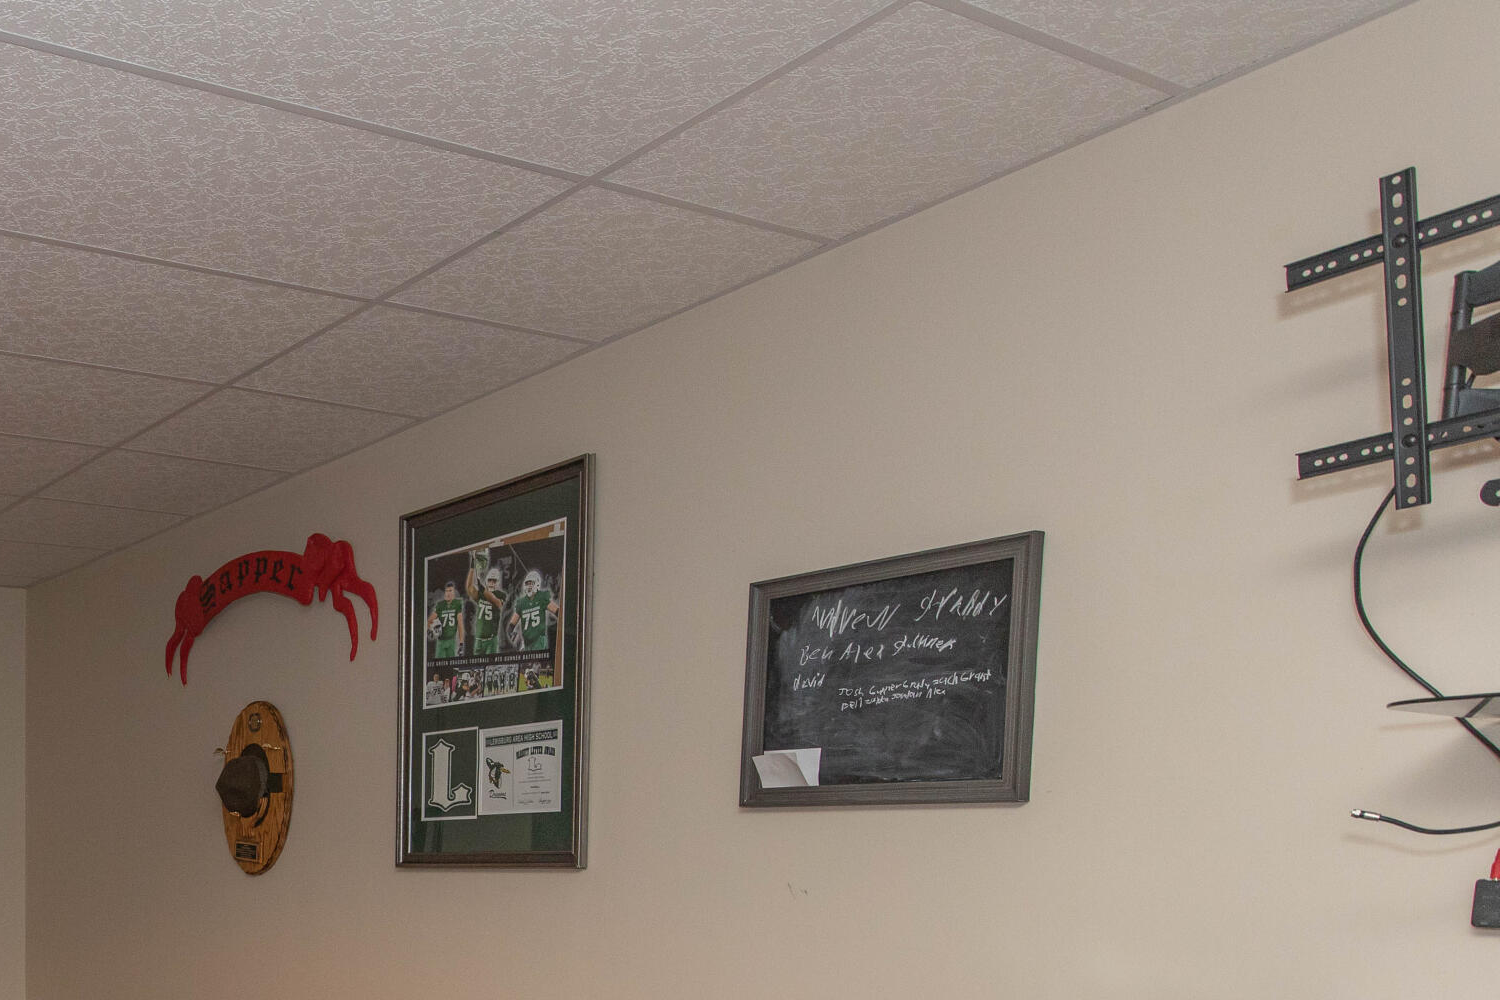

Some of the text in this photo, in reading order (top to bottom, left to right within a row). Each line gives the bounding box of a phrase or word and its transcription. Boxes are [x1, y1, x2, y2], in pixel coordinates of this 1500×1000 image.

[200, 557, 303, 613] Sapper
[442, 613, 456, 628] 75
[478, 604, 493, 620] 75
[521, 611, 541, 630] 75
[428, 738, 473, 813] L
